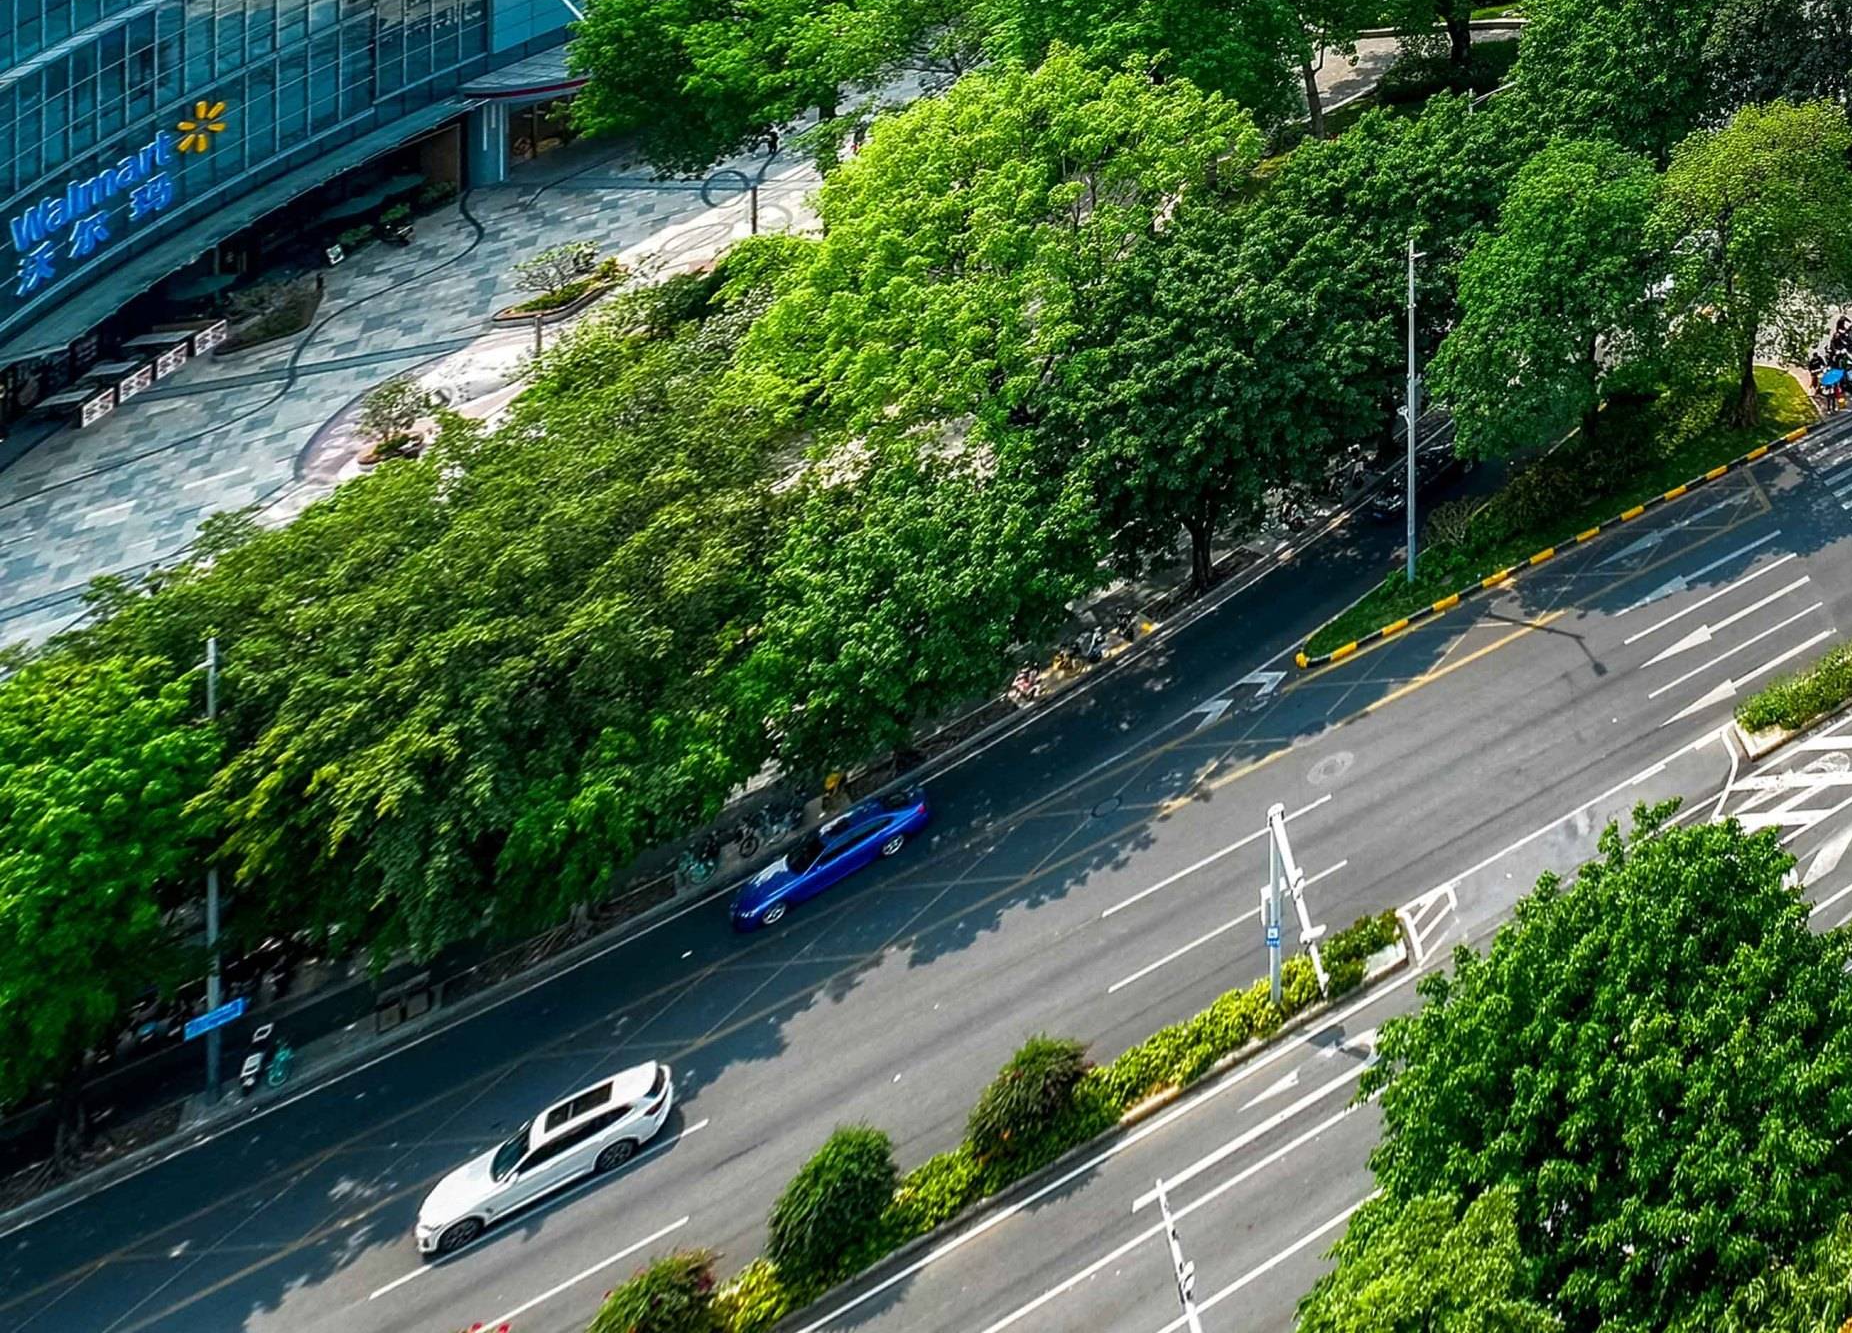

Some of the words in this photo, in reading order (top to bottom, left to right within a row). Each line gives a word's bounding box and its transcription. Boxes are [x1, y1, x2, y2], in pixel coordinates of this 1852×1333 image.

[10, 129, 172, 253] Walmart
[14, 171, 173, 297] 沃尔玛
